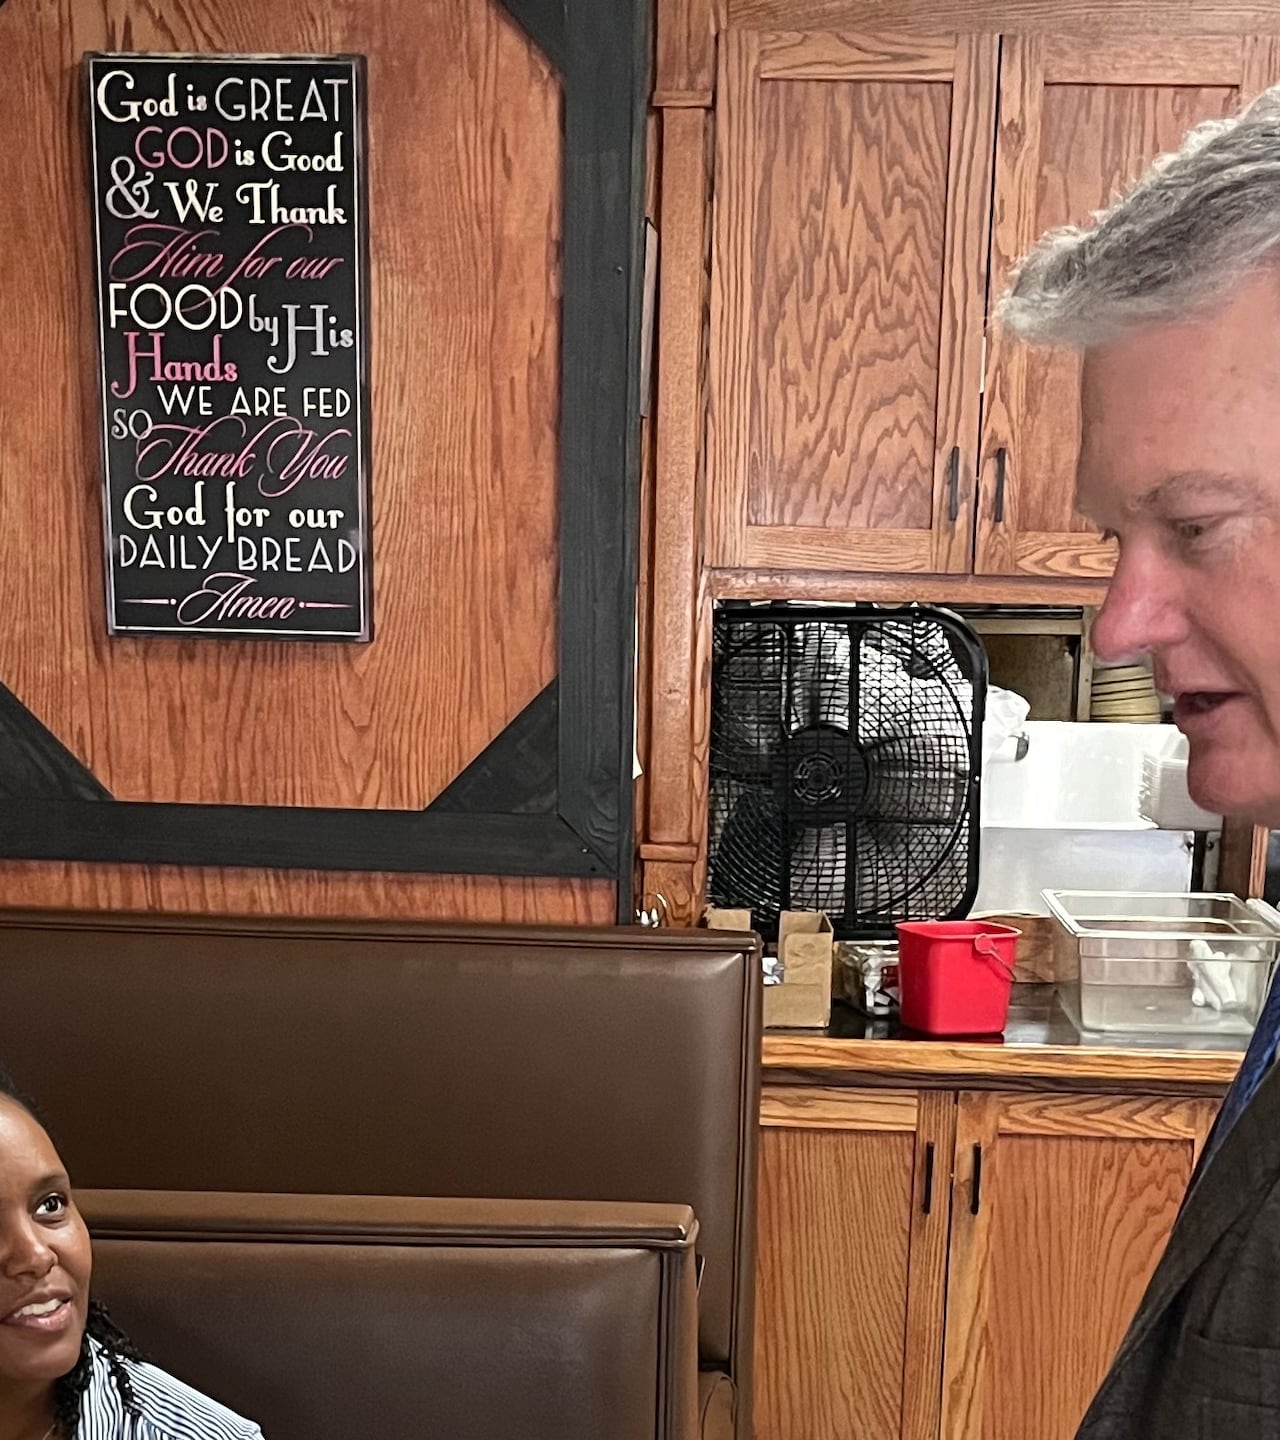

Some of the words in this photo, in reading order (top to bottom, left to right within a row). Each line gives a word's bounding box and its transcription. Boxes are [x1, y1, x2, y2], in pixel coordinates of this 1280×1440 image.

[97, 70, 179, 122] God
[186, 84, 207, 111] is
[214, 78, 349, 122] GREAT
[135, 126, 228, 169] GOD
[234, 139, 255, 166] is
[261, 130, 344, 172] Good
[105, 156, 160, 219] &
[163, 179, 223, 223] We
[235, 179, 347, 224] Thank
[109, 223, 223, 281] Him
[285, 257, 344, 279] our
[109, 283, 242, 330] FOOD
[249, 294, 279, 346] by
[267, 304, 353, 373] His
[110, 332, 238, 398] Hands
[157, 384, 213, 415] WE
[231, 386, 288, 417] ARE
[303, 387, 351, 418] FED
[136, 414, 302, 481] Thank
[258, 417, 352, 497] You
[123, 481, 206, 529] God
[224, 481, 270, 543] for
[288, 508, 344, 529] our
[120, 534, 223, 570] DAILY
[237, 536, 357, 573] BREAD
[176, 572, 296, 625] Amen
